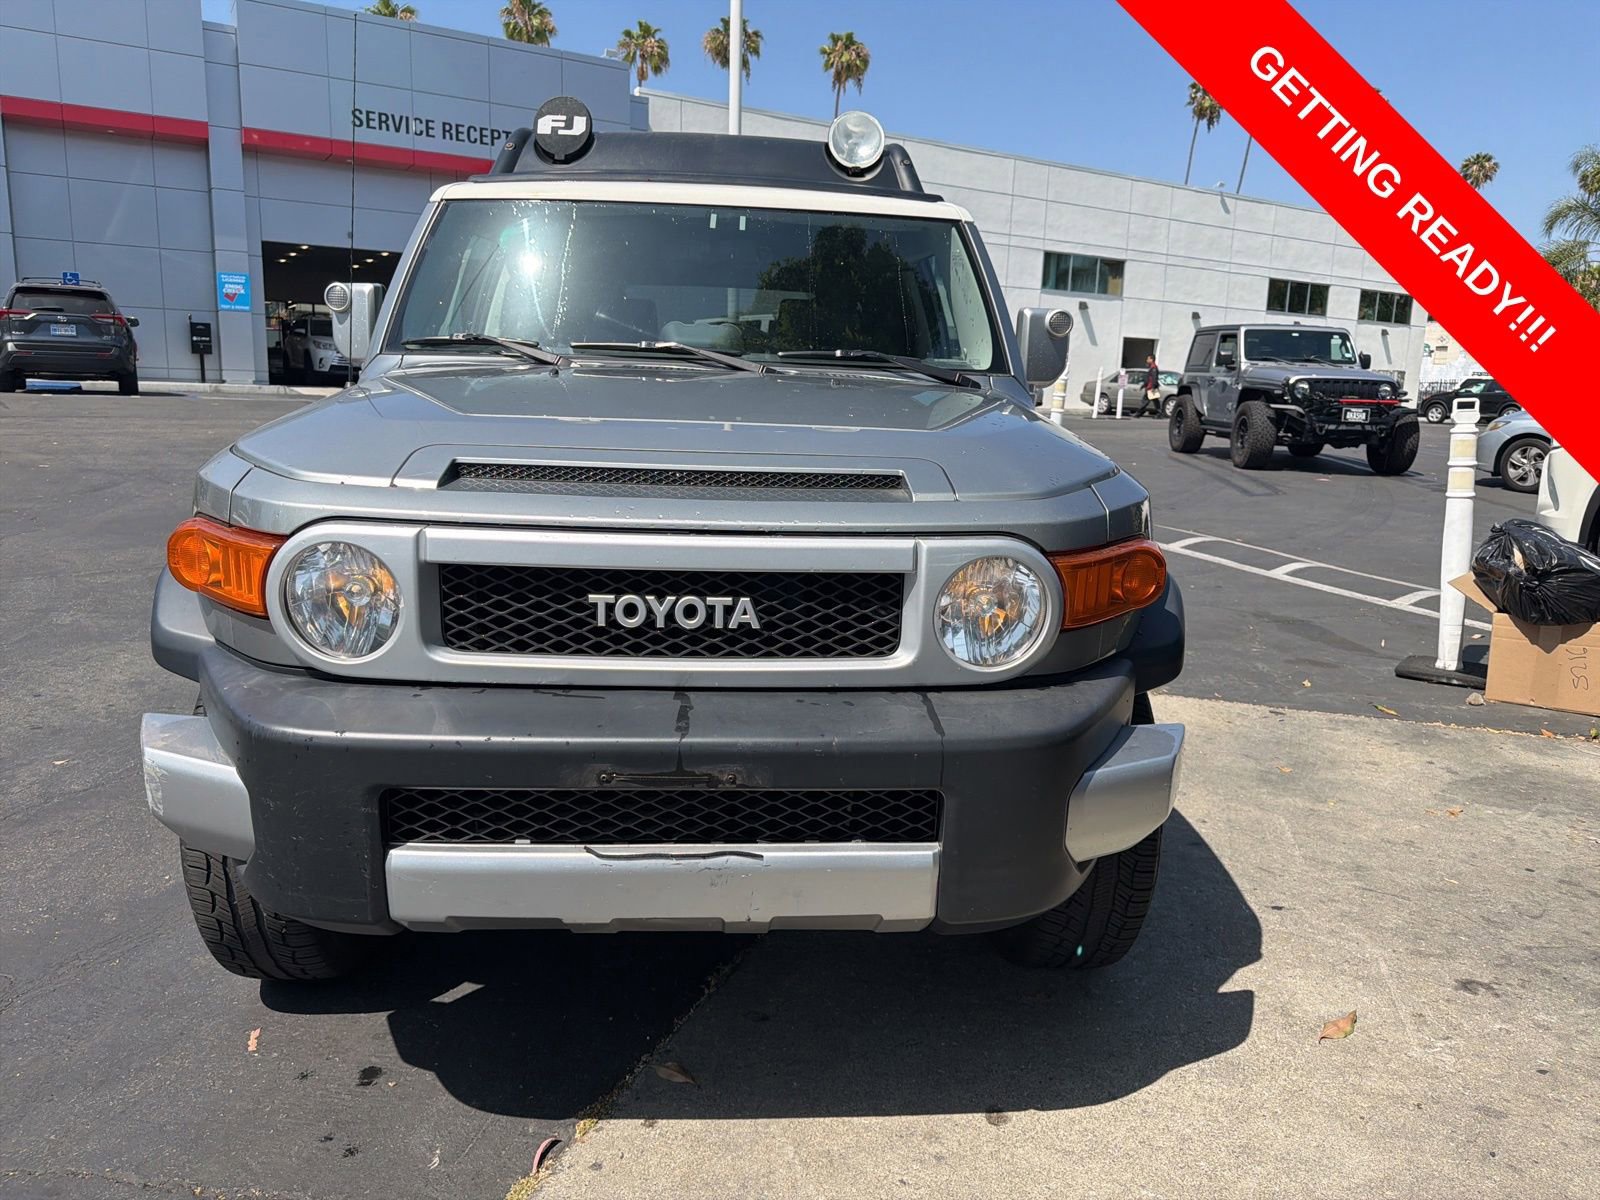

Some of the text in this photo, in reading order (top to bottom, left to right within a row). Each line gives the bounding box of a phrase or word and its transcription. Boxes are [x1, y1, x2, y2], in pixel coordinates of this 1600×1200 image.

[351, 108, 436, 138] SERVICE
[537, 115, 587, 136] FJ
[588, 594, 761, 629] TOYOTA
